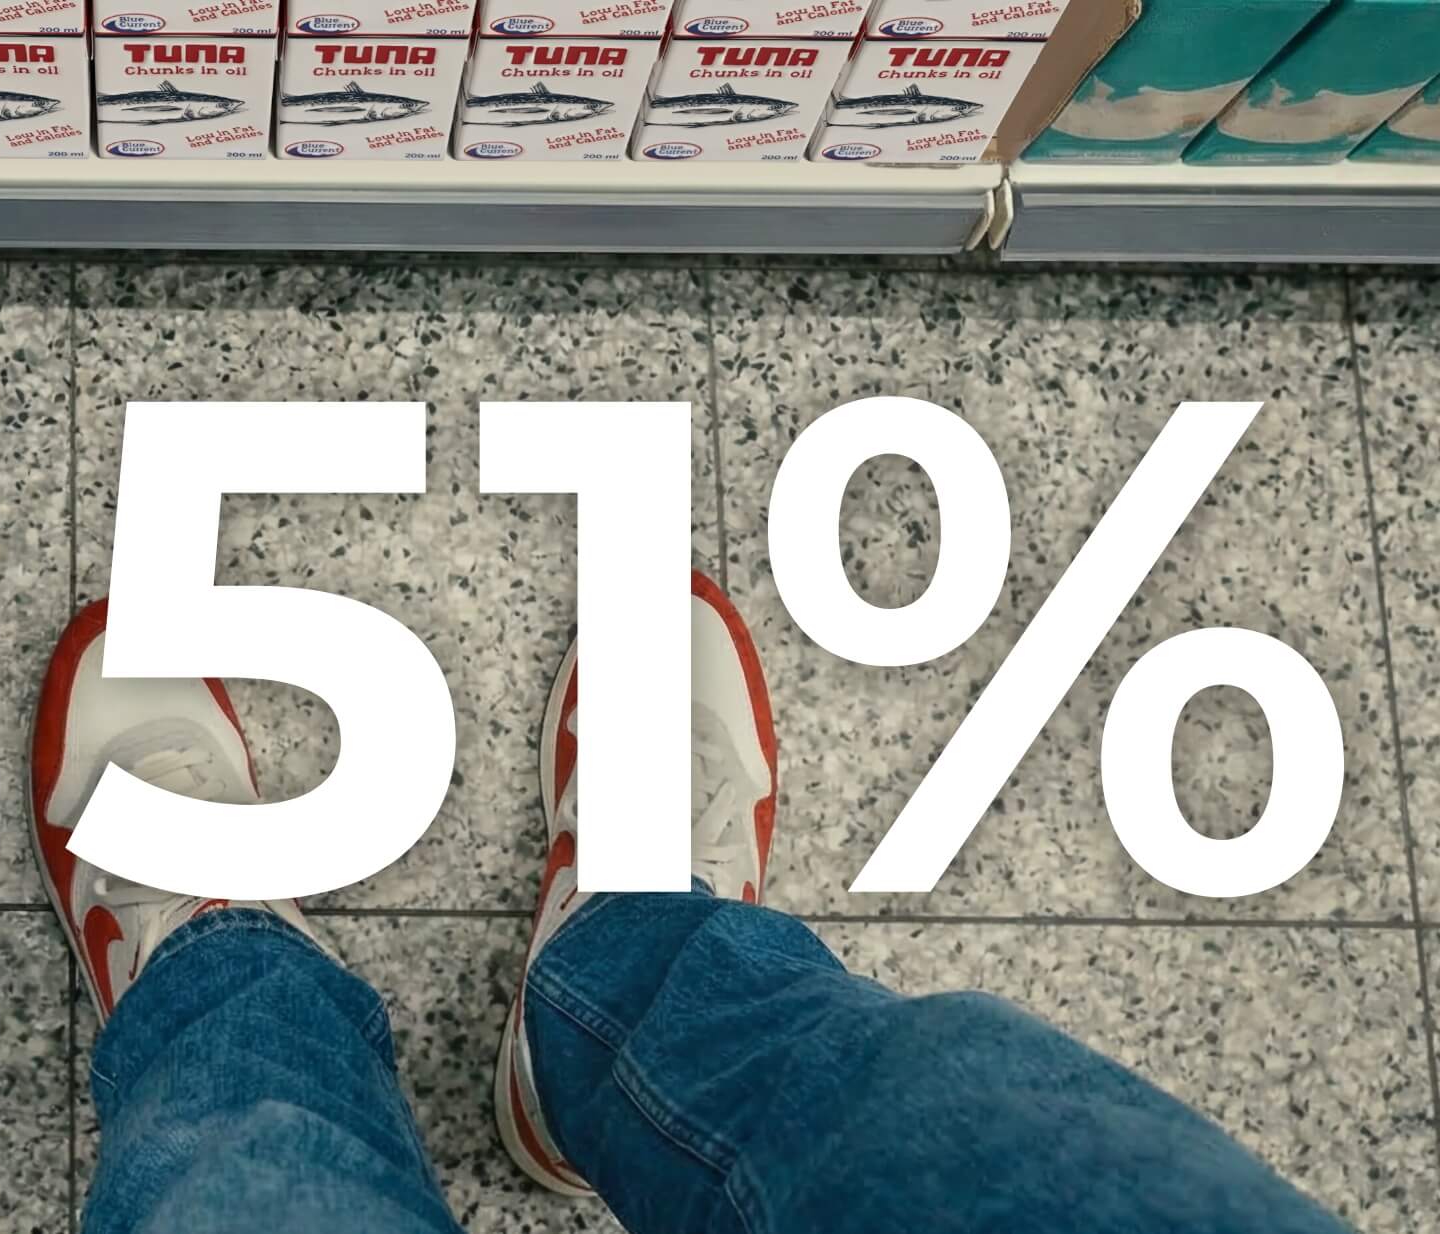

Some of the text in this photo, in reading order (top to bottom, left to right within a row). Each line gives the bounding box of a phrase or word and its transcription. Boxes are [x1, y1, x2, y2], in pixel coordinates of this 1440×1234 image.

[25, 2, 76, 16] Calories
[192, 2, 273, 23] and Calories
[387, 3, 470, 24] and Calories
[582, 4, 665, 25] and Calories
[776, 5, 862, 26] and Calories
[972, 6, 1059, 27] and Calories
[123, 44, 245, 63] TUNA
[315, 45, 437, 64] TUNA
[506, 46, 627, 65] TUNA
[697, 47, 819, 66] TUNA
[889, 48, 1010, 66] TUNA
[38, 67, 59, 75] oil
[125, 66, 248, 75] Chunks in oil
[313, 68, 435, 76] Chunks in oil
[501, 69, 570, 77] Chunks
[602, 69, 624, 77] oil
[689, 70, 813, 78] Chunks in oil
[878, 70, 1002, 79] Chunks in oil
[5, 132, 35, 141] Low
[51, 124, 73, 133] Fat
[10, 130, 83, 147] and Calories
[186, 133, 215, 142] Low
[233, 125, 254, 133] Fat
[190, 131, 264, 148] and Calories
[366, 133, 396, 143] Low
[413, 126, 435, 134] Fat
[369, 131, 444, 150] and Calories
[546, 134, 575, 144] Low
[549, 132, 625, 150] and Calories
[726, 137, 755, 145] Low
[777, 128, 799, 138] Fat
[906, 137, 937, 145] Low
[959, 129, 980, 138] Fat
[727, 133, 806, 151] and Calories
[907, 134, 987, 151] and Calories
